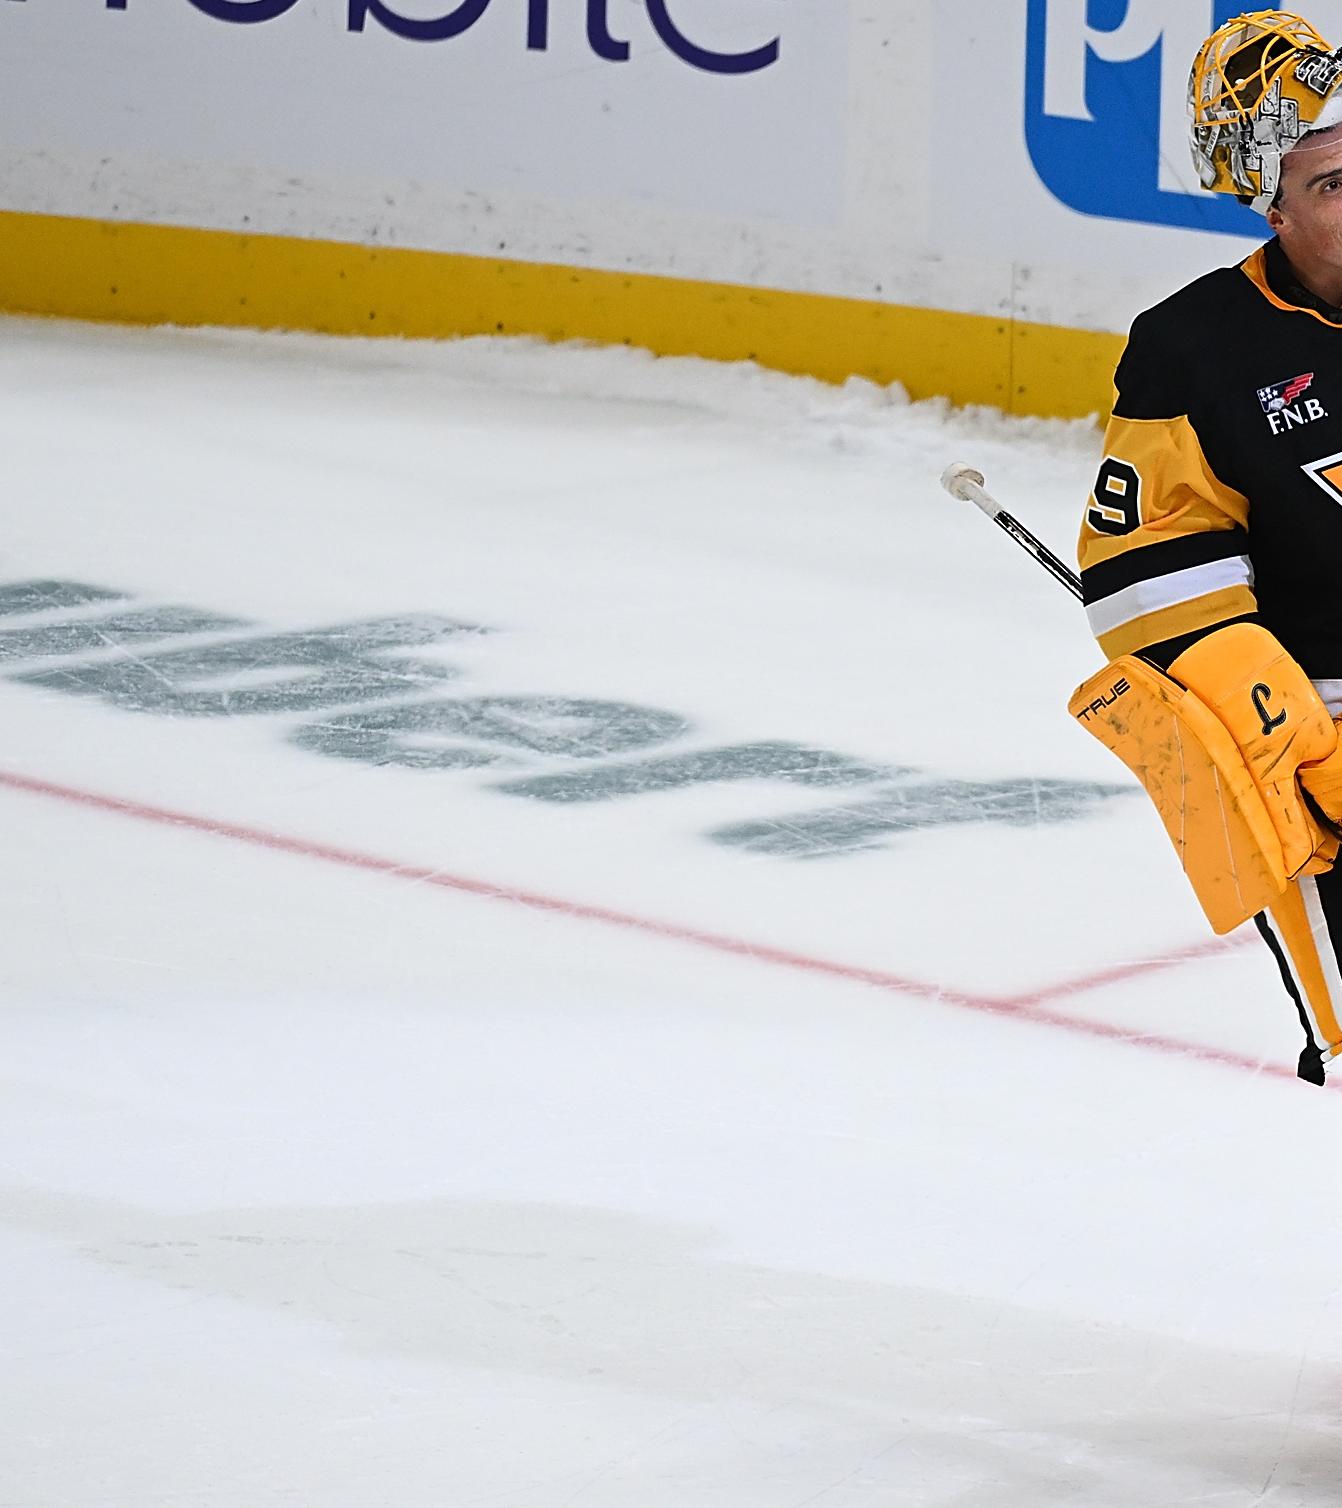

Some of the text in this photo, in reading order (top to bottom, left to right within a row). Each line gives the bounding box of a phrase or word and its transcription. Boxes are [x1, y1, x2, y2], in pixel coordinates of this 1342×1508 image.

[1266, 398, 1329, 435] F.N.B.
[1086, 454, 1143, 536] 9
[1077, 677, 1131, 721] TRUE
